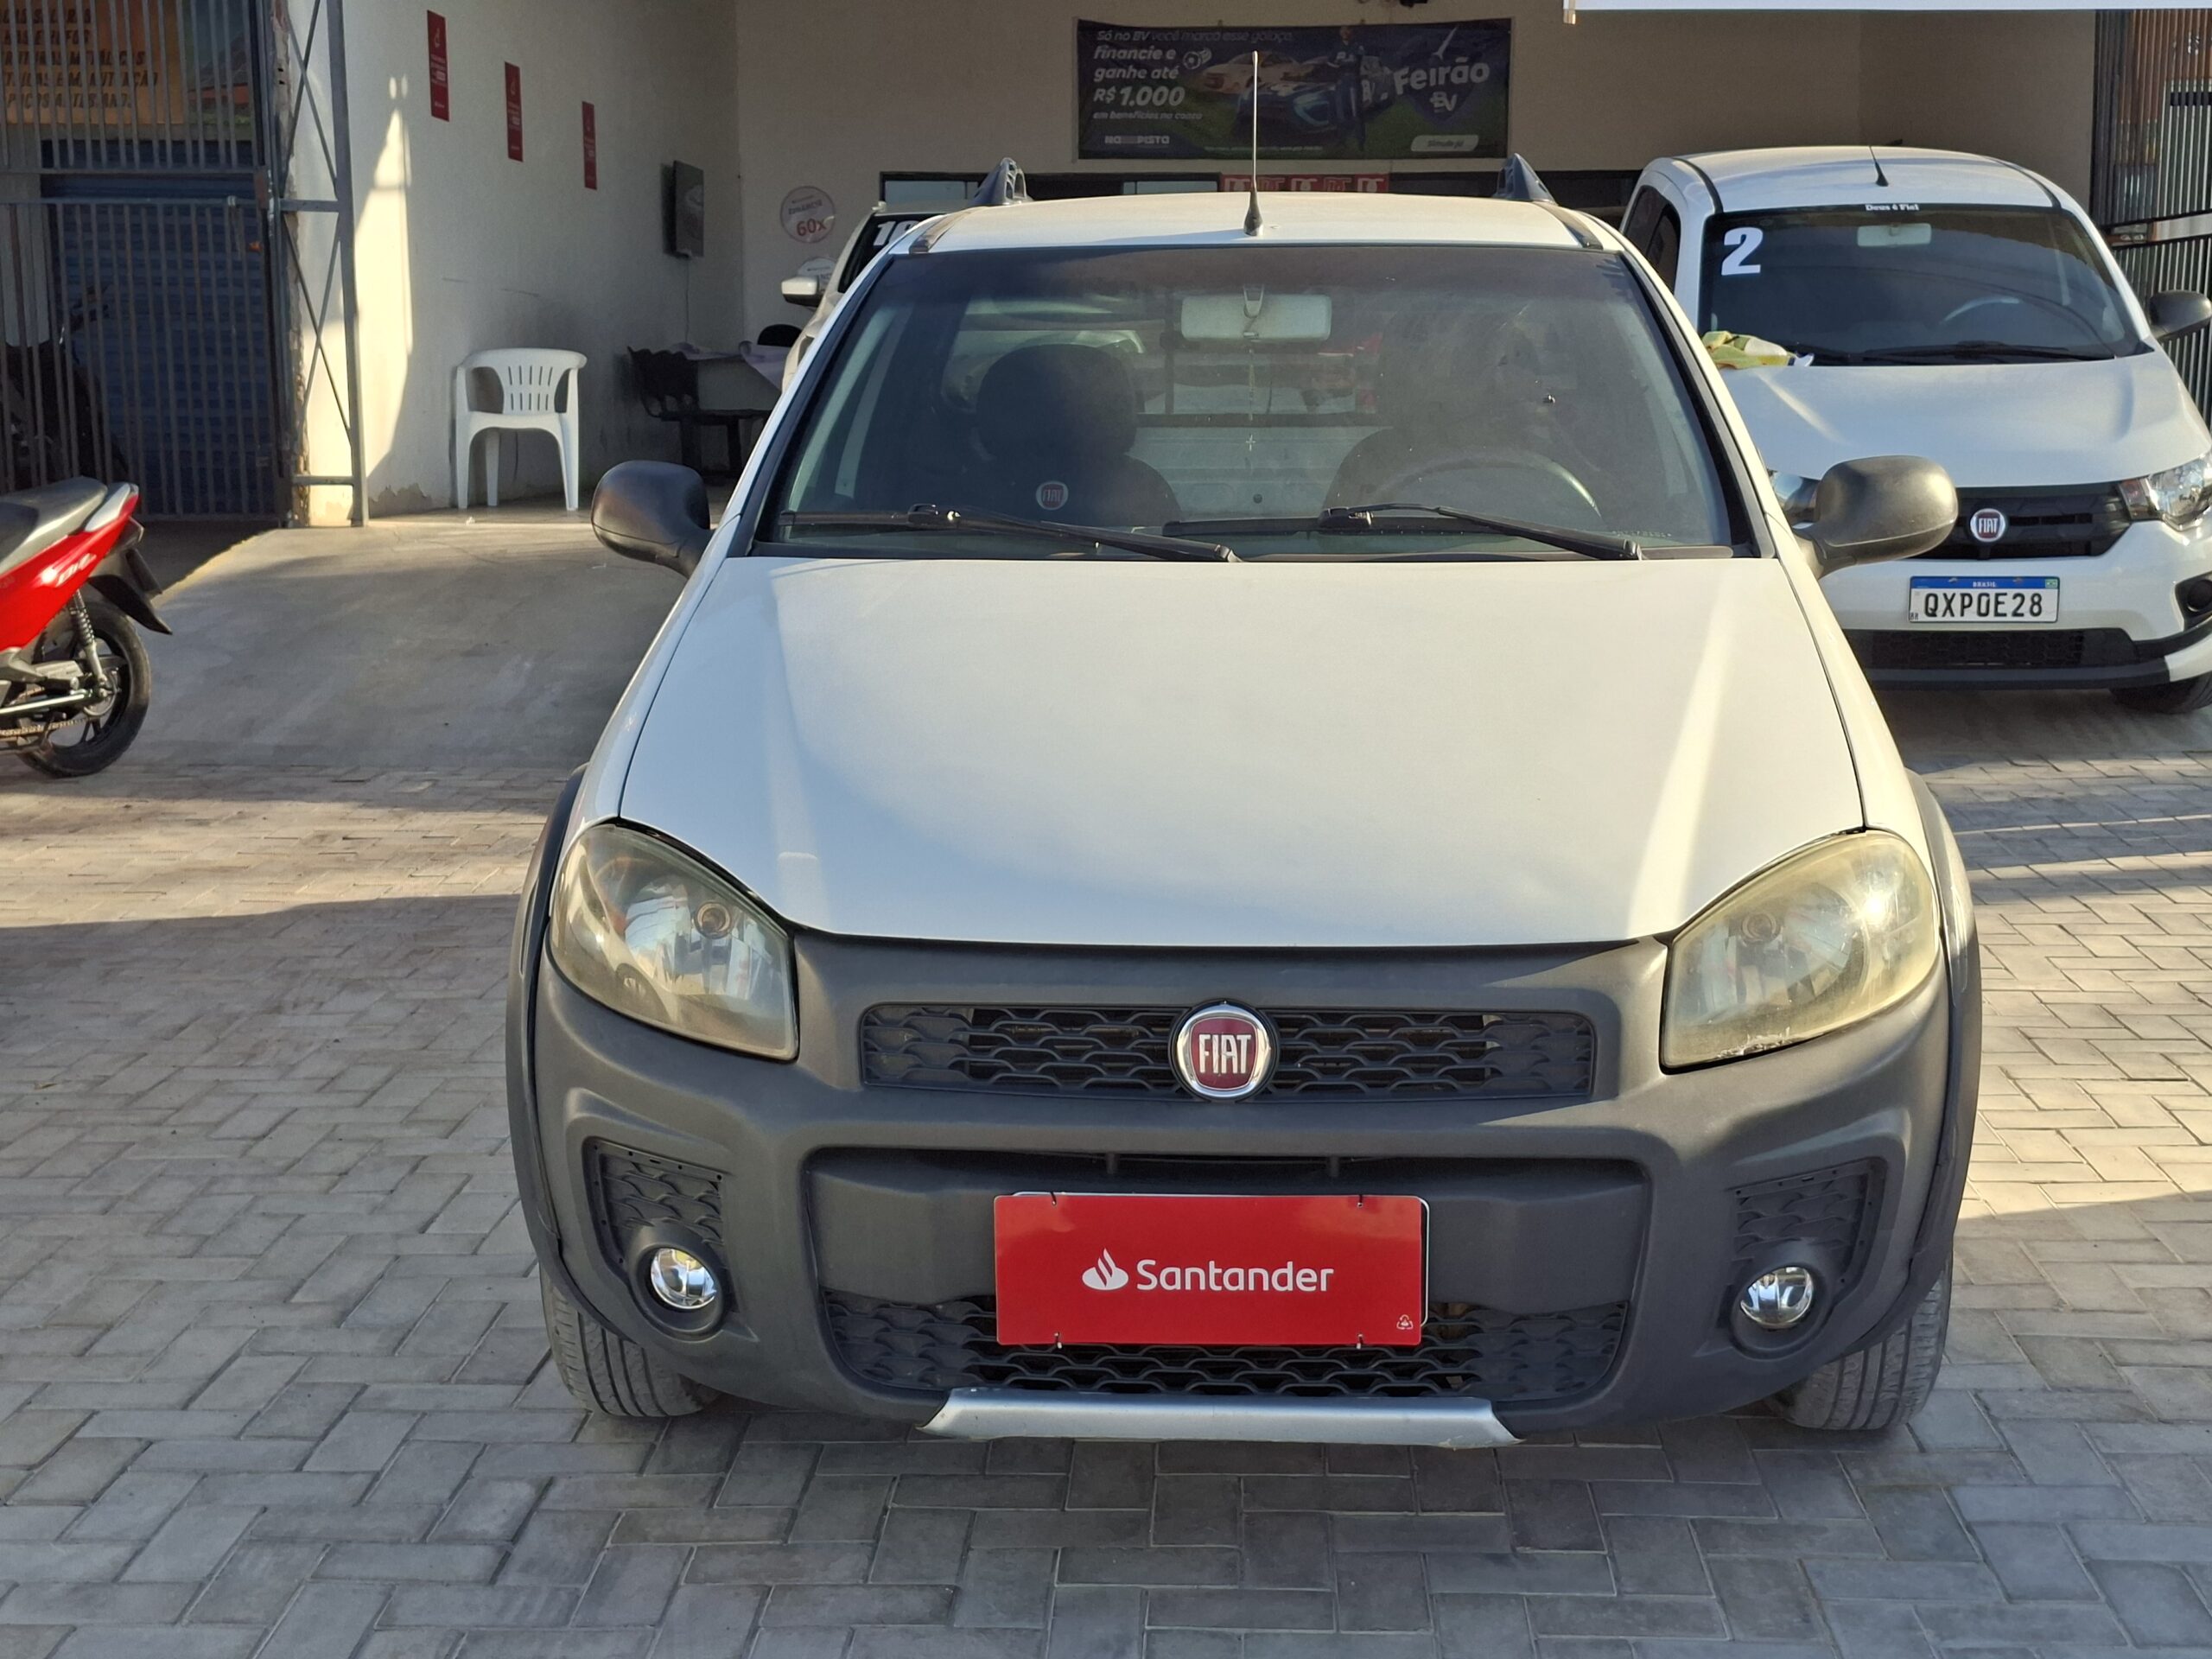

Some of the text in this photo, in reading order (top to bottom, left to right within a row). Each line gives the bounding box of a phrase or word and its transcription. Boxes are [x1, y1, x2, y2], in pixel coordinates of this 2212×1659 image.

[1096, 30, 1113, 41] Só
[1133, 30, 1149, 41] BV
[1094, 46, 1177, 60] financie e
[1094, 65, 1179, 81] ganhe até
[1393, 56, 1491, 95] Feirão
[1093, 86, 1185, 106] R$ 1.000
[797, 218, 827, 237] 60x
[1720, 226, 1764, 276] 2
[1978, 518, 1999, 533] FIAT
[1198, 1033, 1252, 1074] FIAT
[1136, 1260, 1335, 1292] Santander
